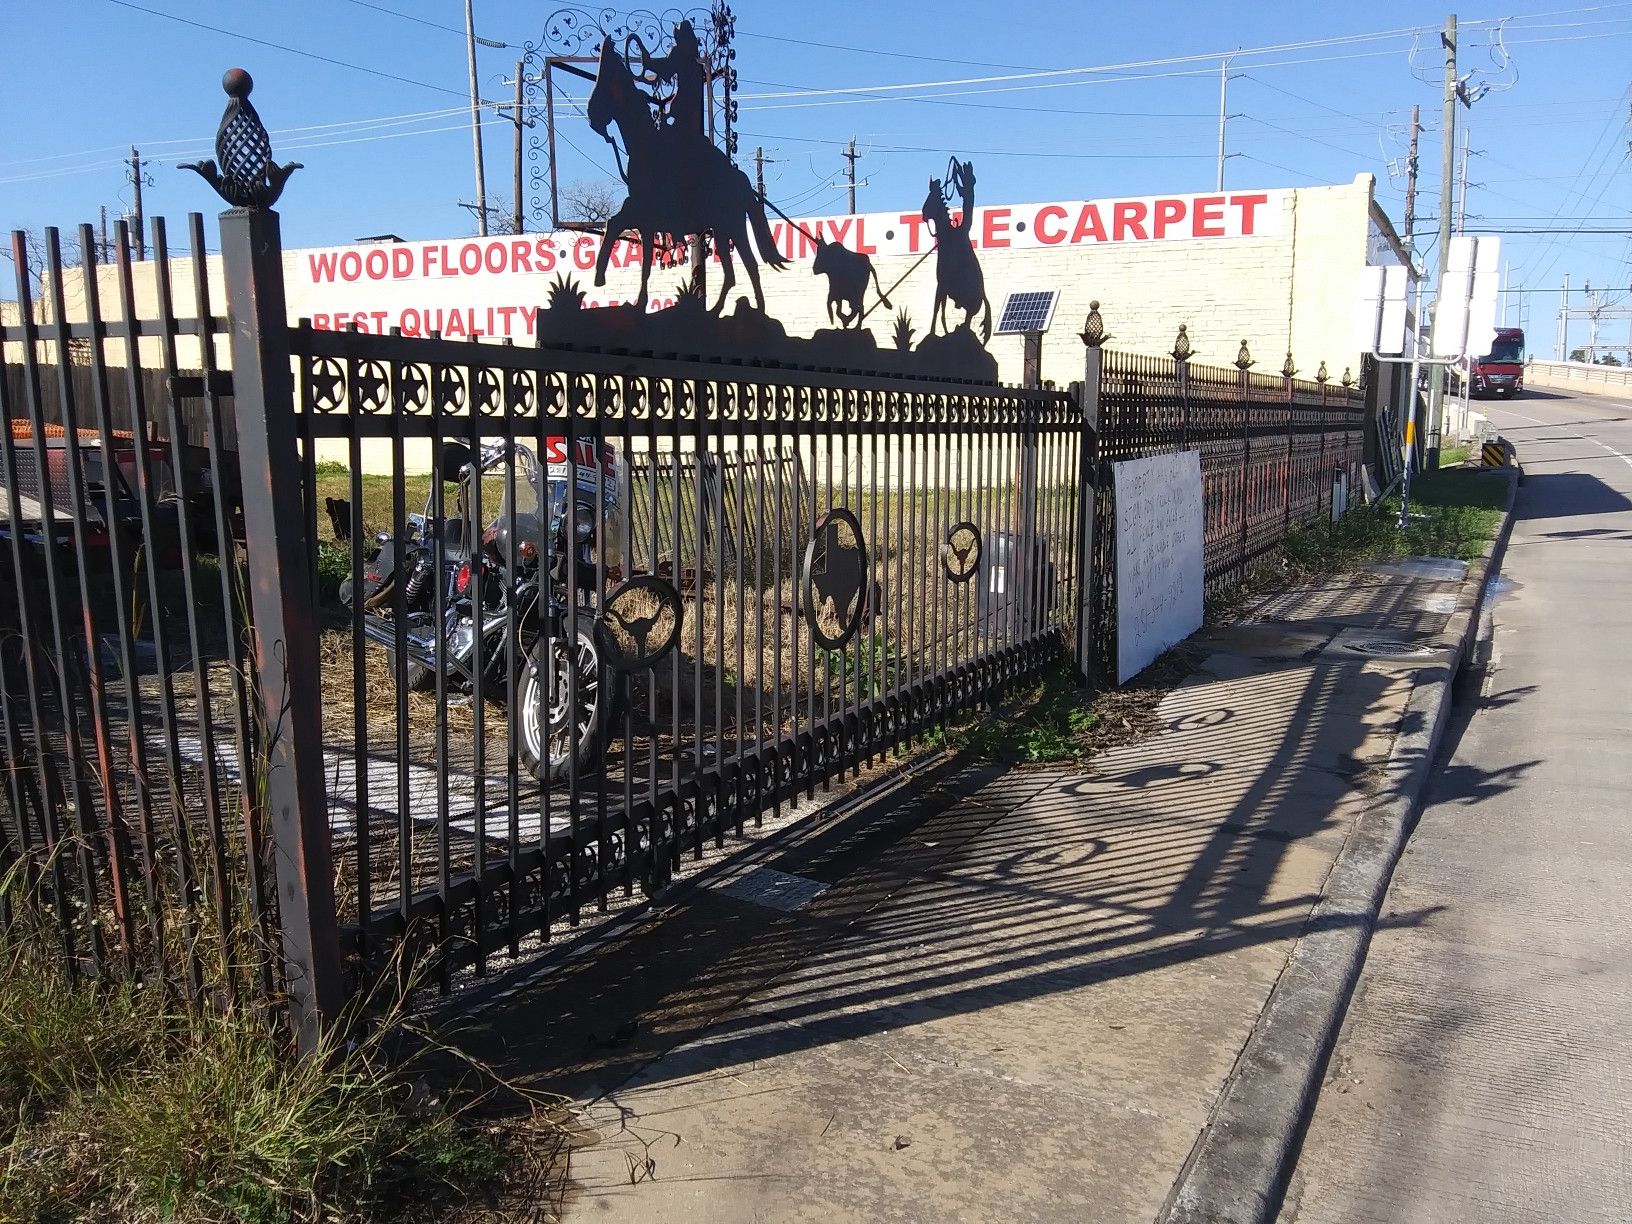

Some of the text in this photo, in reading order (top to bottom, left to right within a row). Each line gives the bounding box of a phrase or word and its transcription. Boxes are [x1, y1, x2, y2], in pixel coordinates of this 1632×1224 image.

[308, 247, 414, 283] WOOD
[422, 238, 556, 277] FLOORS
[899, 209, 1011, 252] TE
[1033, 194, 1268, 244] CARPET
[313, 305, 540, 338] BEST QUALITY
